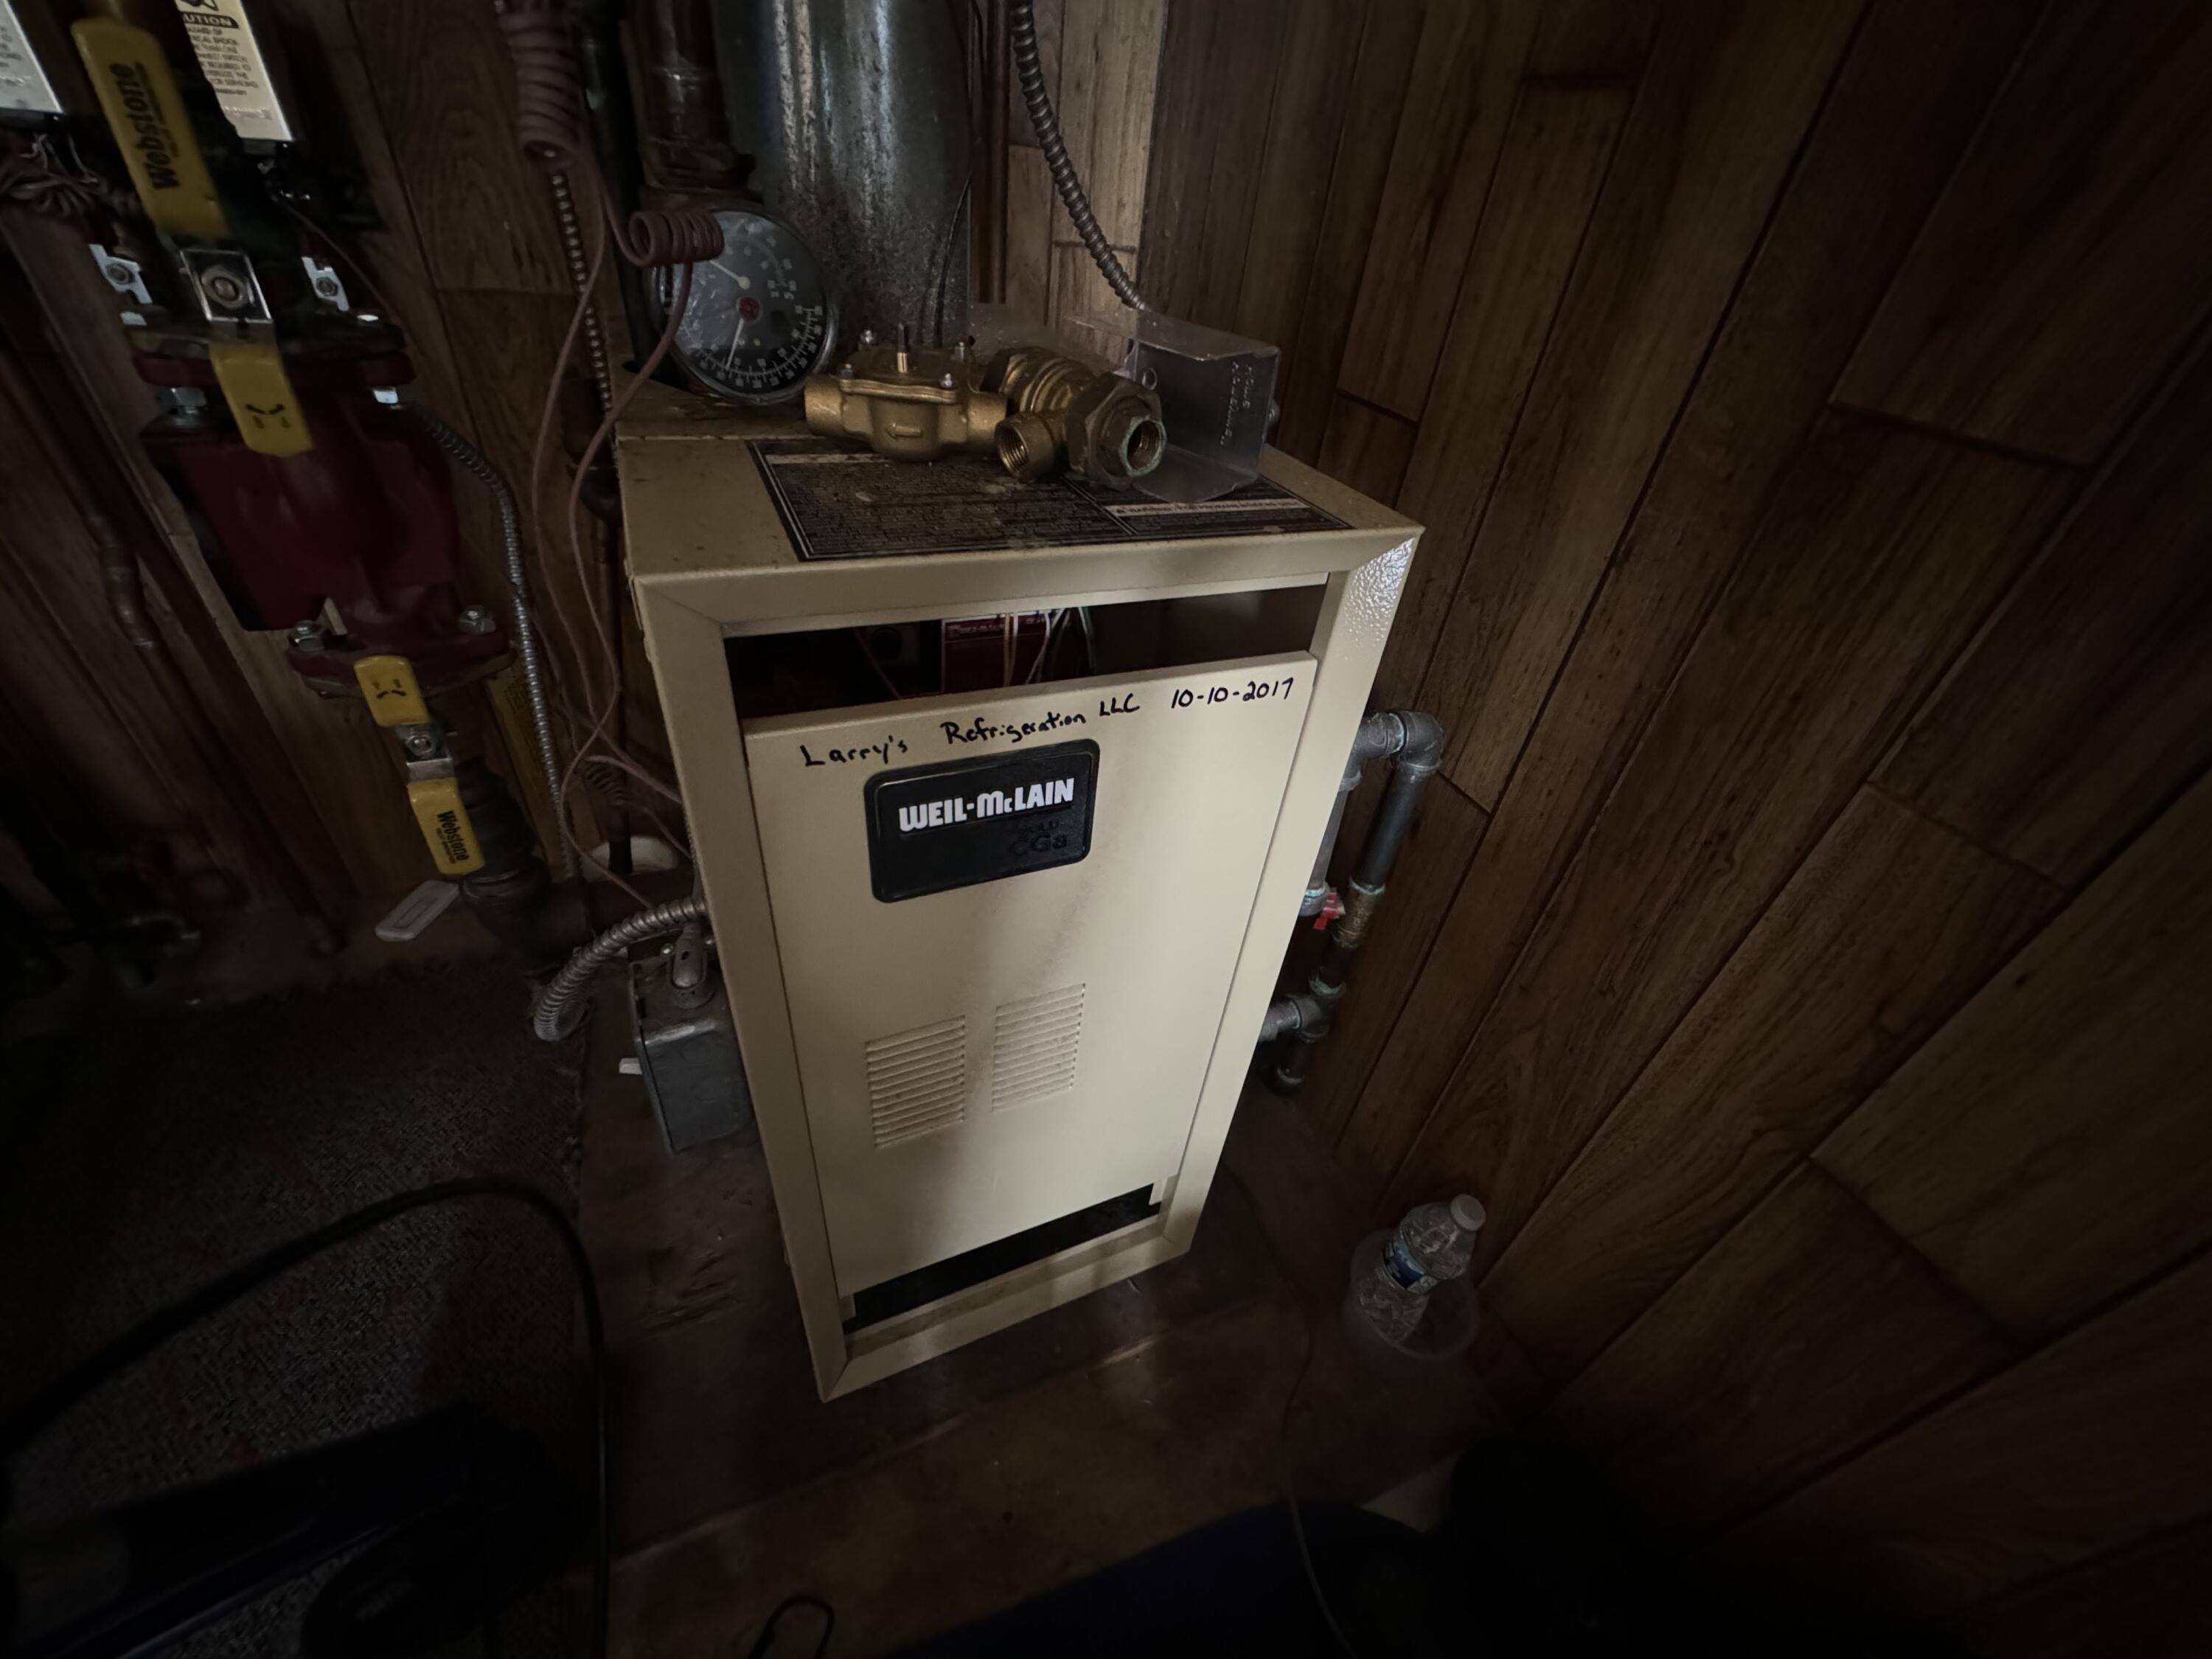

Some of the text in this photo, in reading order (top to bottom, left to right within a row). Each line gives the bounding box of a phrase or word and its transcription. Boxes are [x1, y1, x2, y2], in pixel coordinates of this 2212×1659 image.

[184, 14, 232, 27] UTION
[109, 63, 180, 189] Webstone
[800, 677, 1294, 766] Larry's Refrigeration LLC 10-10-2017
[437, 810, 469, 862] Webstone
